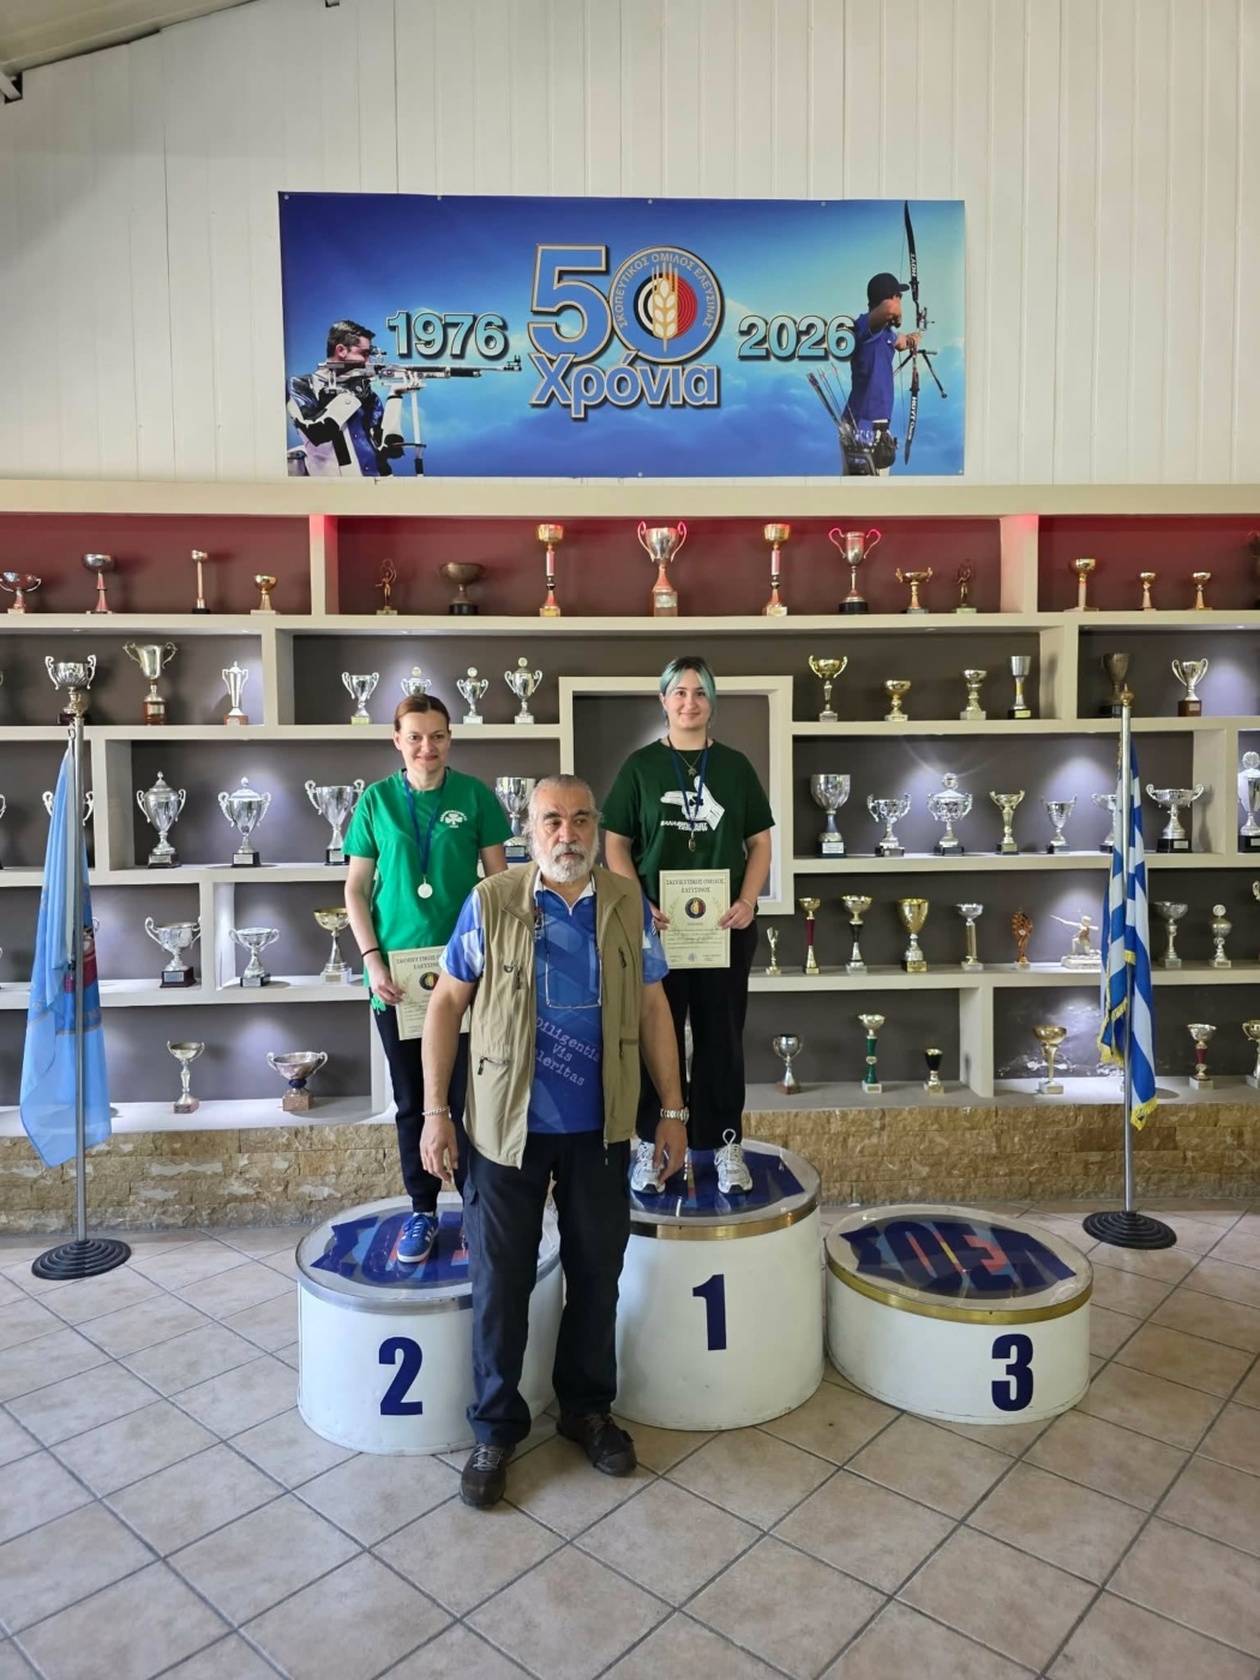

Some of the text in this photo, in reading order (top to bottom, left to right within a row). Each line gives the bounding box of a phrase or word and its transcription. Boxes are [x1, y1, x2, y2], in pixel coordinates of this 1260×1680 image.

[528, 244, 722, 363] 50
[614, 253, 716, 329] ΣΚΟΠΕΥΤΙΚΟΣ ΟΜΙΛΟΣ ΕΛΕΥΣΙΝΑΣ
[387, 311, 507, 358] 1976
[738, 315, 856, 361] 2026
[529, 349, 720, 418] Χρόνια
[535, 1050, 585, 1086] leritas
[552, 1043, 573, 1062] Vis
[692, 1274, 727, 1352] 1
[378, 1336, 423, 1416] 2
[992, 1334, 1034, 1412] 3
